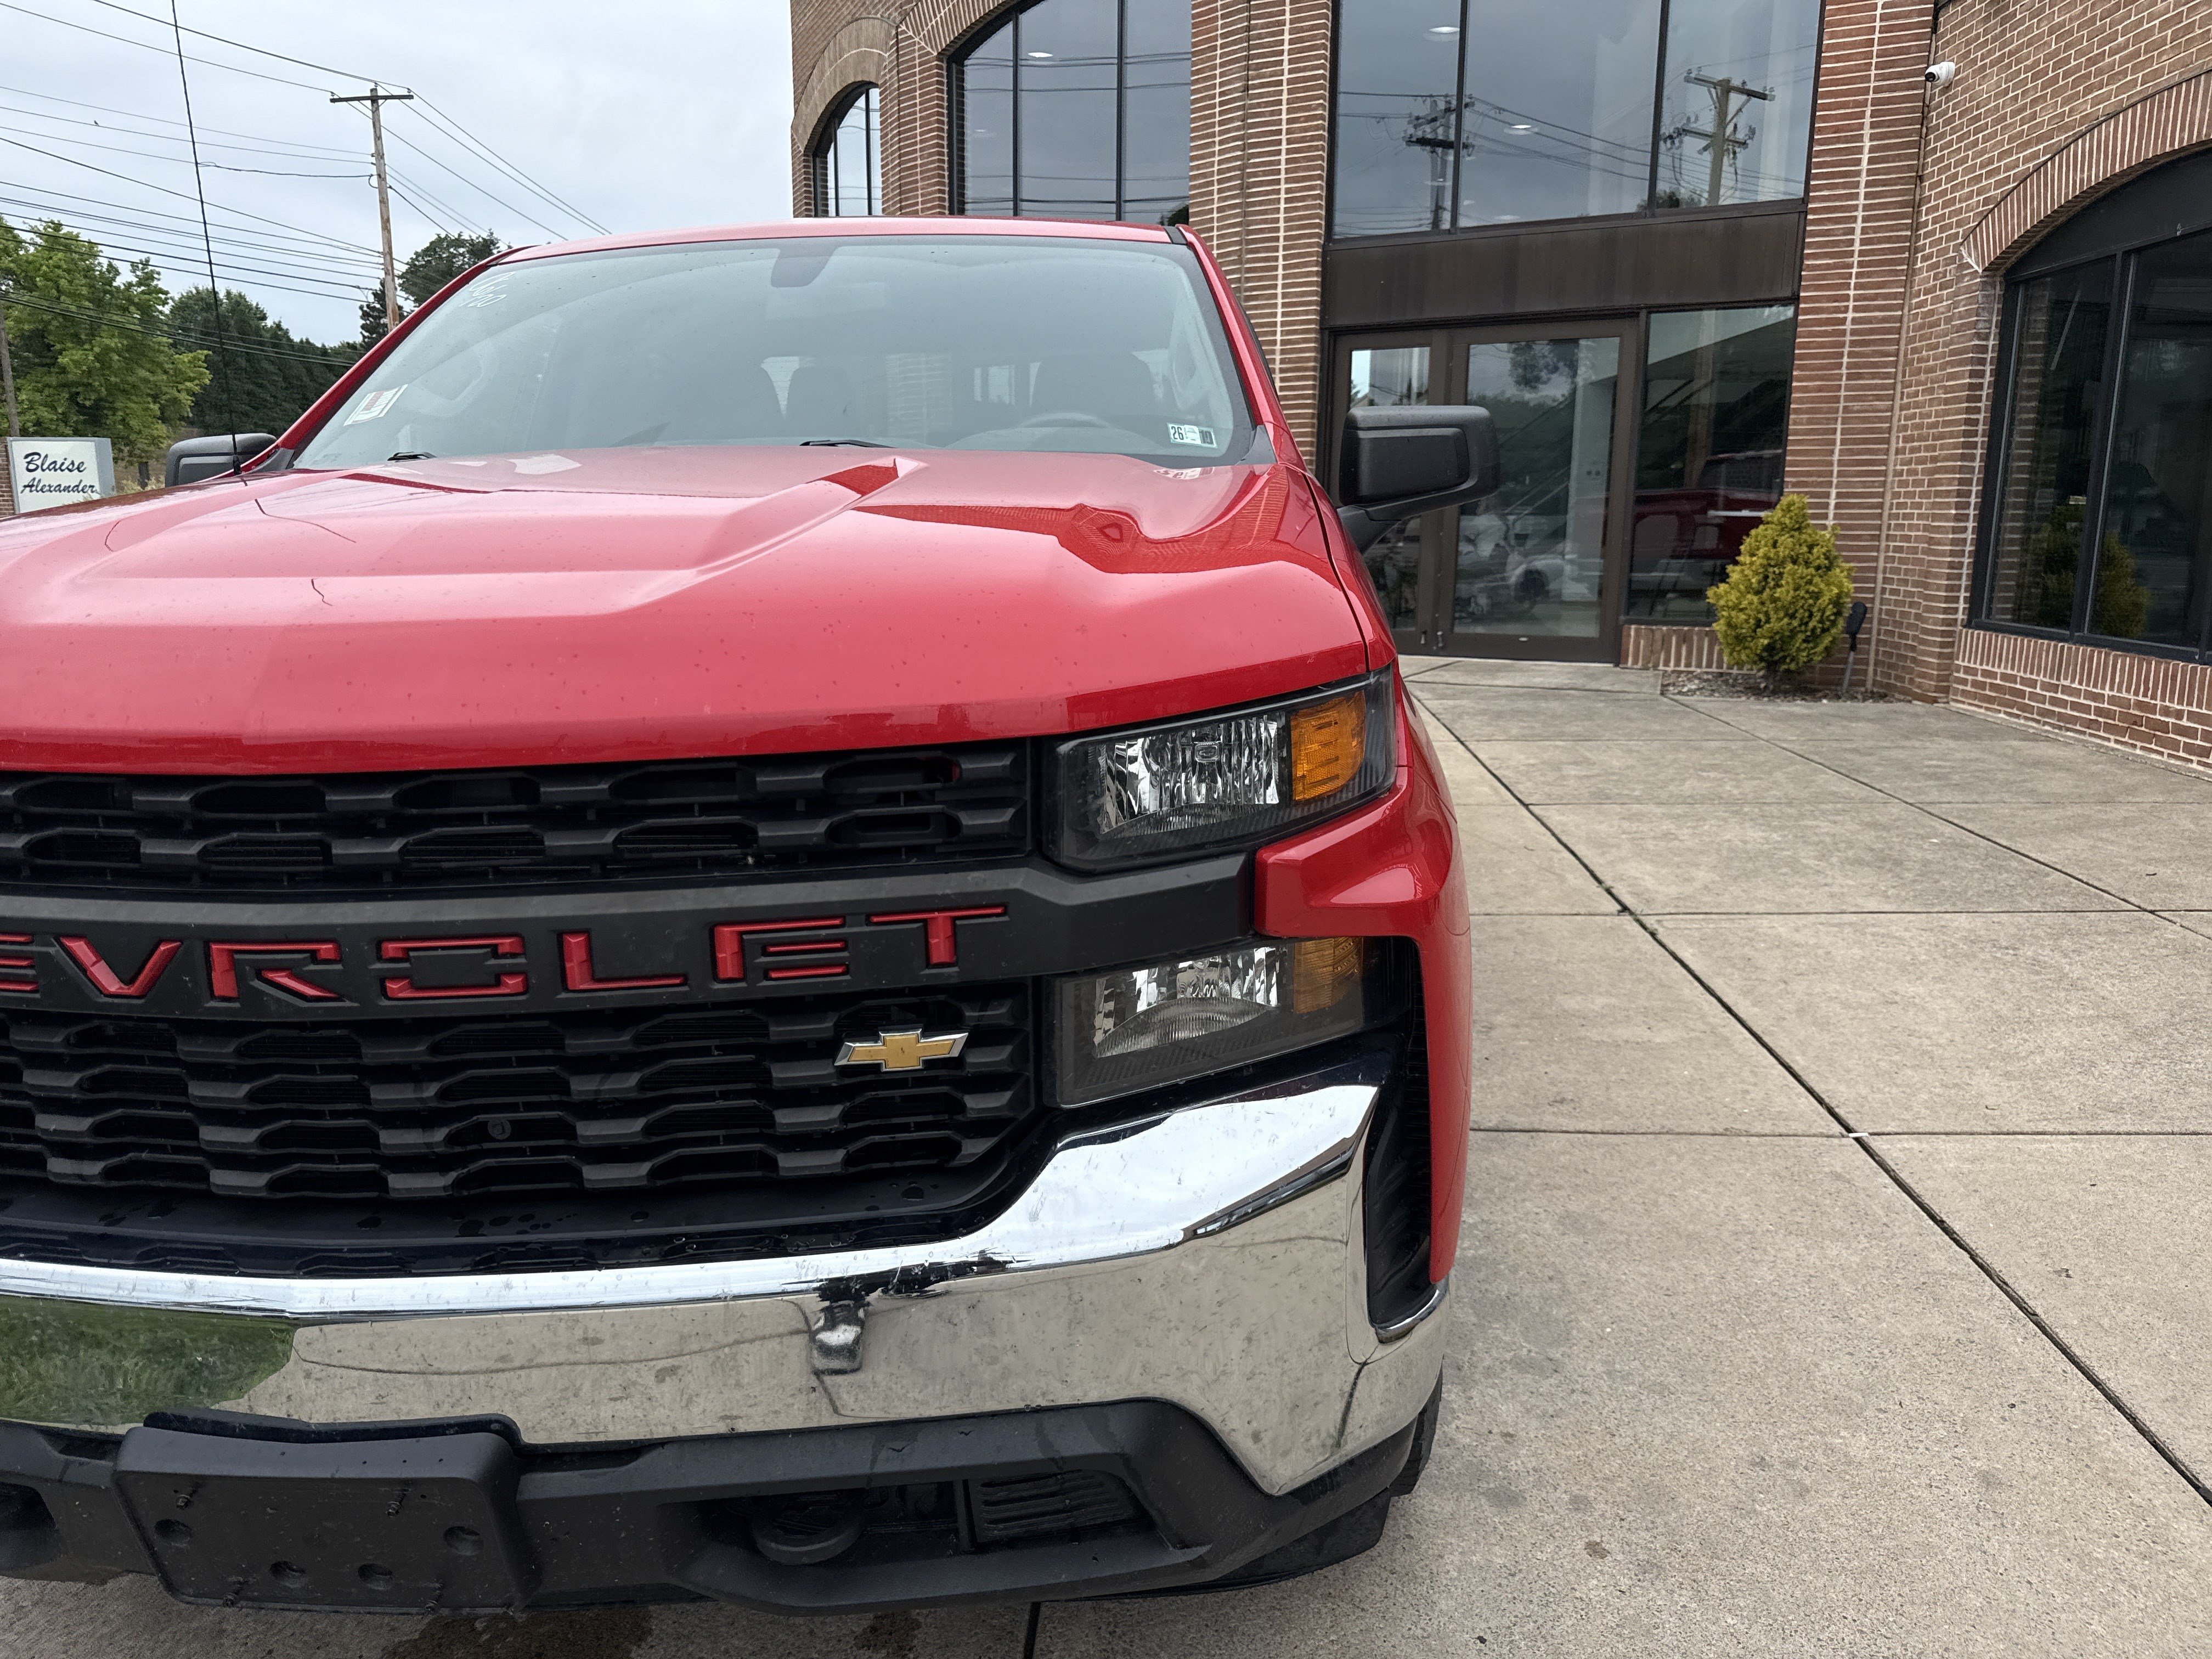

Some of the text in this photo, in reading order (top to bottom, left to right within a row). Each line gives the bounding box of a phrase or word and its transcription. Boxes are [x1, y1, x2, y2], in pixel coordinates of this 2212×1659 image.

[1171, 426, 1184, 441] 26
[23, 452, 87, 473] Blaise
[20, 477, 98, 494] Alexander
